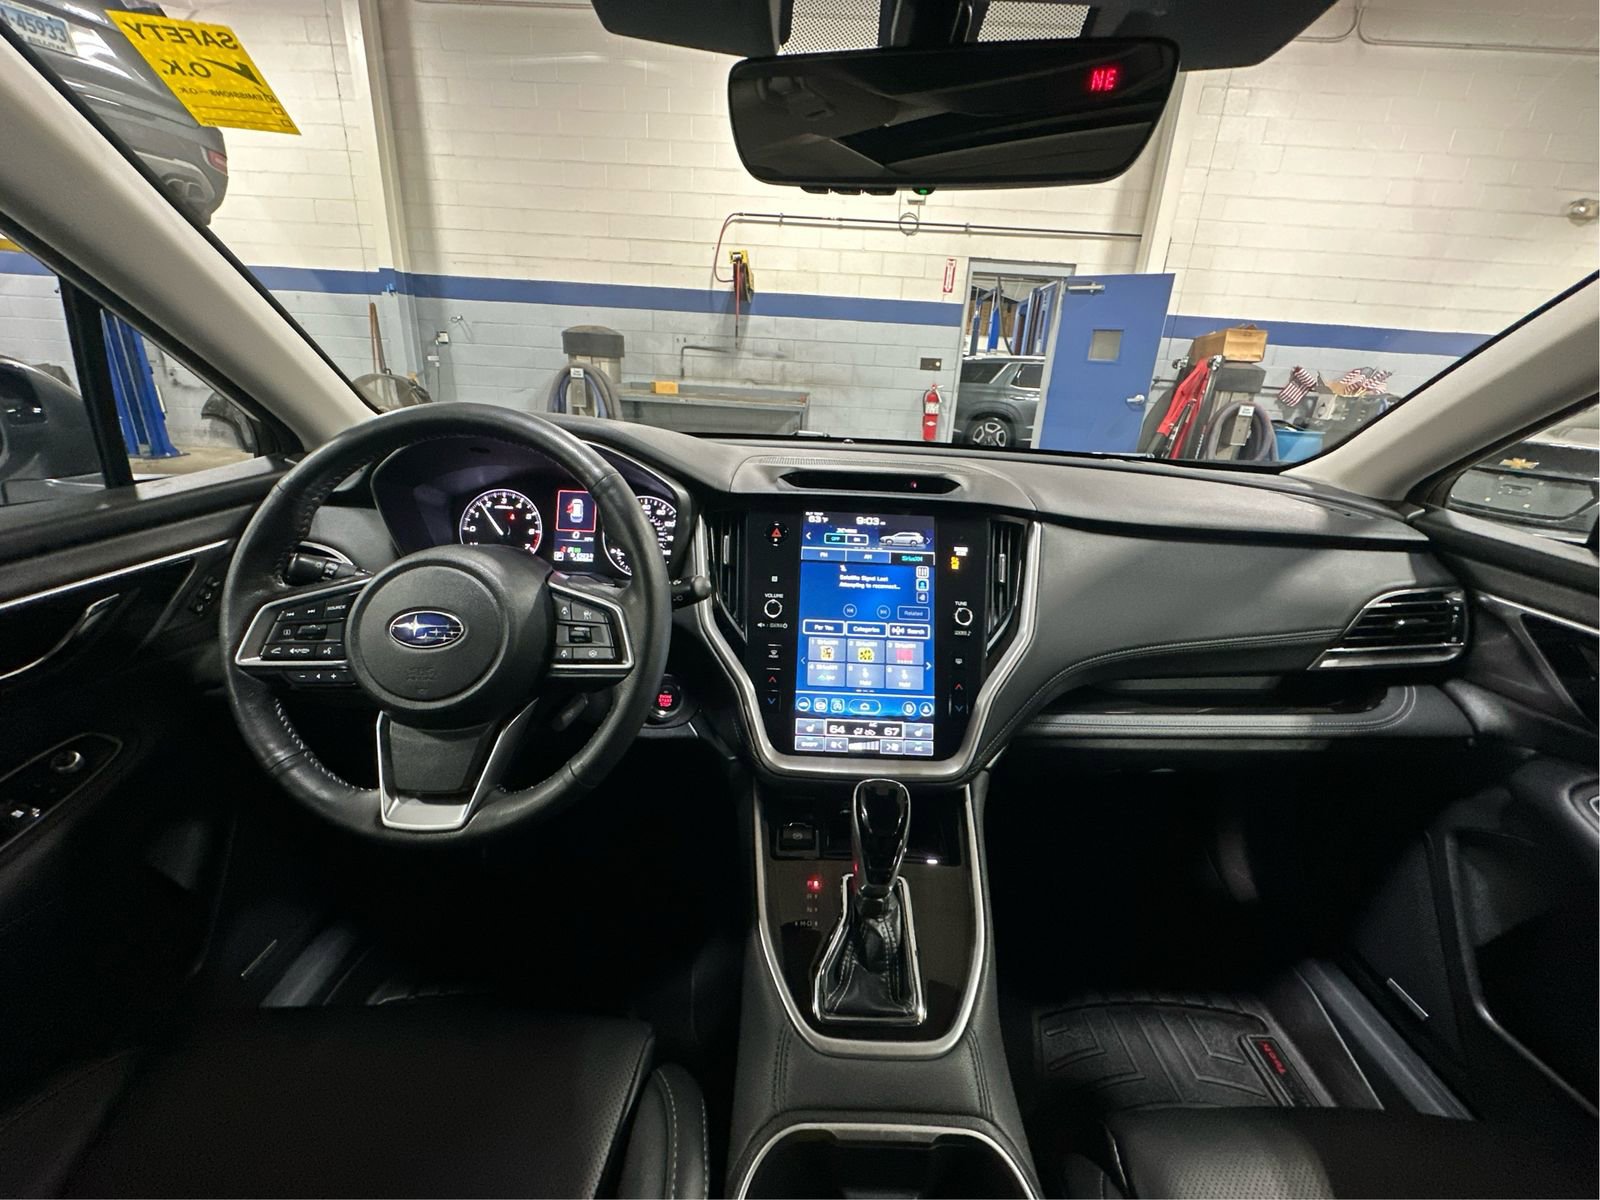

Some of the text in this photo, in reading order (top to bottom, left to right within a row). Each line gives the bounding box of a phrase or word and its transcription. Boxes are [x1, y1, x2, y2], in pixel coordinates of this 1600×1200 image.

[1091, 70, 1116, 91] NE
[829, 725, 845, 734] 64
[884, 727, 900, 736] 67
